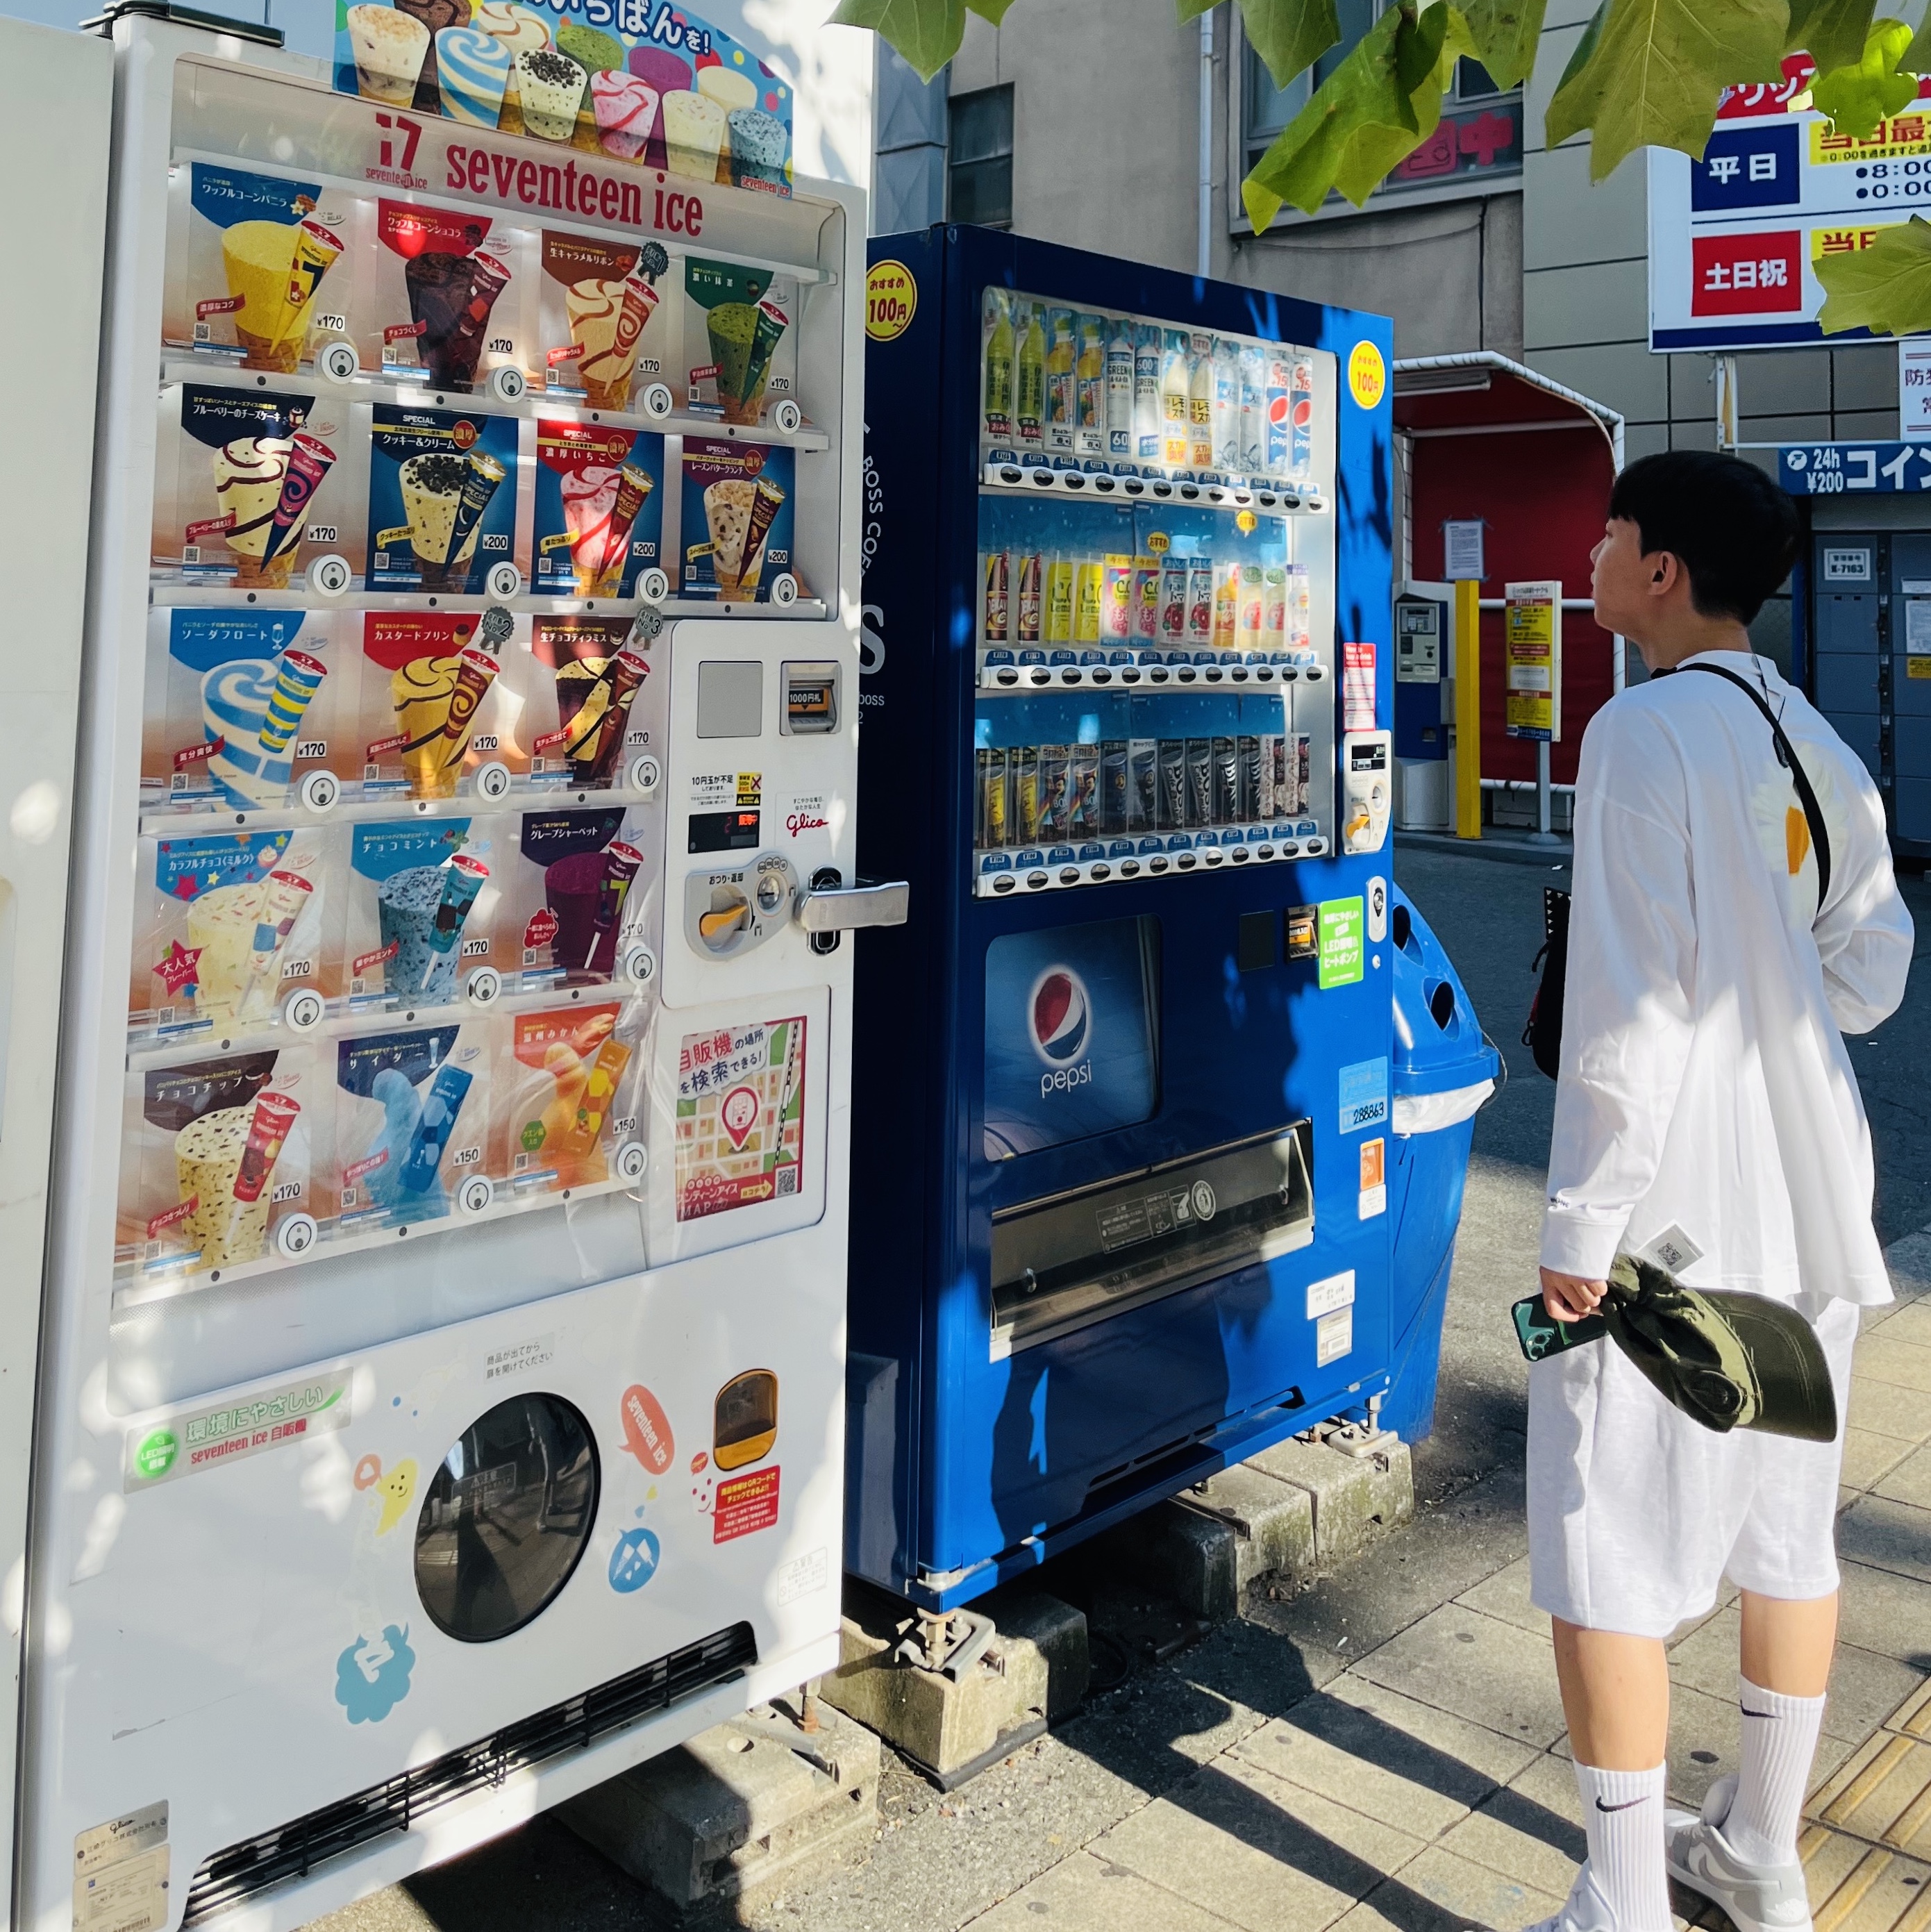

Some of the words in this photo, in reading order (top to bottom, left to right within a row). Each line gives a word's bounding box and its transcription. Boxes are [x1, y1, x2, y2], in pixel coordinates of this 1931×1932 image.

[1710, 152, 1776, 185] 平日
[415, 178, 428, 189] ice
[446, 144, 642, 225] seventeen
[654, 172, 703, 237] ice
[740, 175, 777, 194] seventeen
[778, 182, 790, 197] ice
[202, 185, 287, 207] ワッフルコーンバニラ
[387, 217, 462, 238] ワッフルコーンショコラ
[550, 247, 615, 267] 生キャラメルリボン
[1704, 258, 1787, 290] 土日祝
[869, 277, 905, 291] おすすめ
[869, 297, 906, 323] 100円
[317, 317, 343, 330] ¥170
[490, 340, 512, 352] ¥170
[640, 359, 659, 372] ¥170
[771, 378, 789, 389] ¥170
[193, 404, 281, 423] ブルーベリーのチーズケーキ
[403, 415, 435, 425] SPECIAL
[383, 434, 455, 449] クッキー&クリーム
[563, 429, 592, 440] SPECIAL
[706, 445, 730, 454] SPECIAL
[1814, 448, 1840, 469] 24h
[1806, 471, 1844, 494] ¥200
[309, 528, 336, 542] ¥170
[484, 536, 508, 549] ¥200
[634, 544, 654, 555] ¥200
[769, 551, 787, 563] ¥200
[182, 630, 268, 640] ソーダフロート
[374, 630, 450, 642] カスタードプリン
[540, 632, 607, 643] 生チョコティラミス
[789, 693, 821, 703] 1000円札
[475, 737, 498, 749] ¥170
[628, 733, 649, 744] ¥170
[299, 743, 324, 757] ¥170
[692, 774, 733, 785] 10円玉が不足
[786, 813, 829, 838] Glico
[530, 826, 598, 840] グレープシャーベット
[363, 839, 437, 853] チョコミント
[464, 941, 487, 954] ¥170
[162, 953, 195, 976] 大人気
[284, 962, 310, 976] ¥170
[680, 1028, 764, 1072] 自販機の場所
[350, 1052, 424, 1070] サイダー
[680, 1052, 762, 1094] を検索できる!
[1041, 1059, 1092, 1099] pepsi
[156, 1077, 242, 1102] チョコチップ
[615, 1119, 635, 1132] ¥150
[455, 1149, 479, 1163] ¥150
[274, 1184, 300, 1202] ¥170
[487, 1342, 540, 1366] 商品が出てから
[487, 1352, 553, 1379] 扉を開けてください
[185, 1386, 323, 1443] 環境にやさしい
[627, 1394, 658, 1450] seventeen
[653, 1442, 667, 1466] ice
[191, 1437, 248, 1465] seventeen
[252, 1430, 268, 1447] ice
